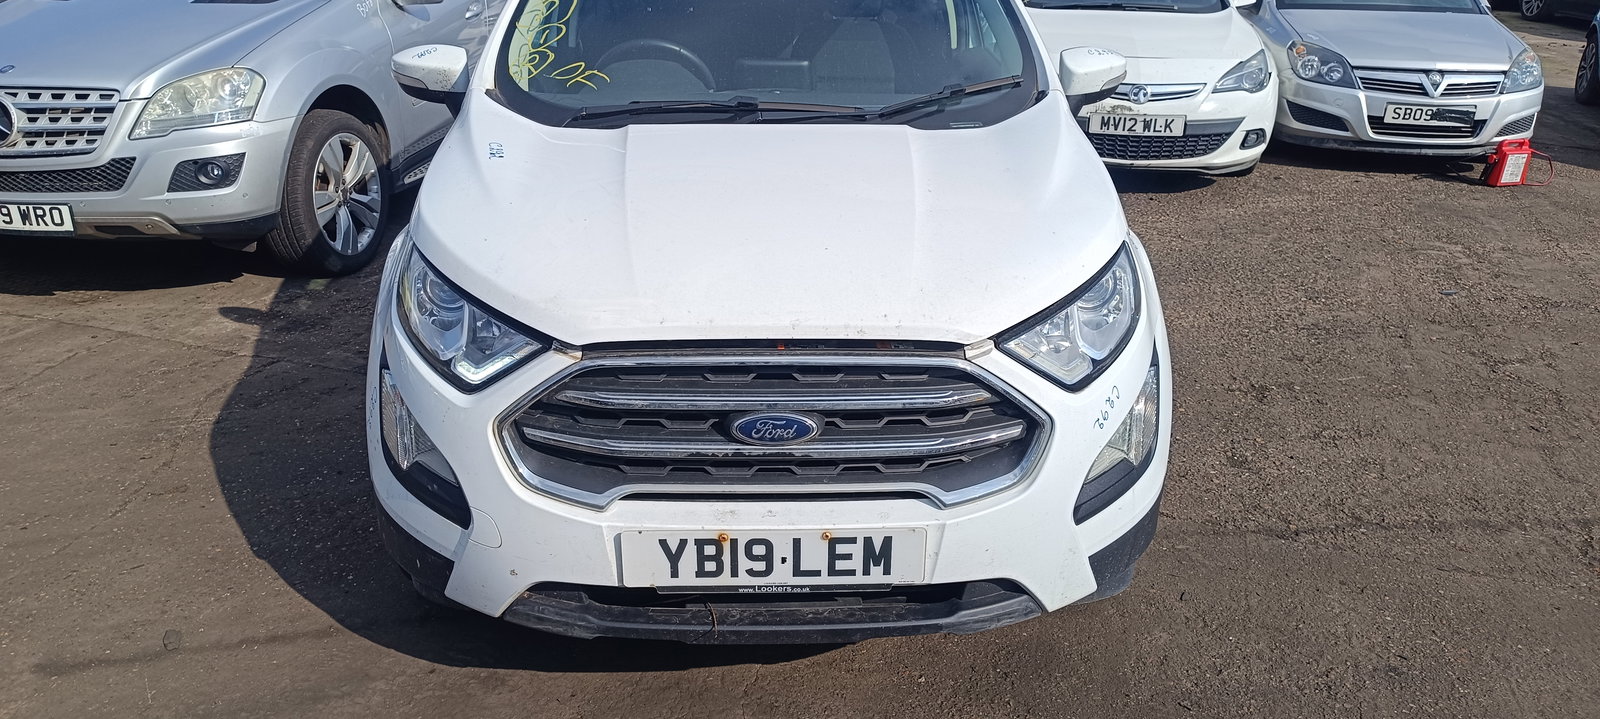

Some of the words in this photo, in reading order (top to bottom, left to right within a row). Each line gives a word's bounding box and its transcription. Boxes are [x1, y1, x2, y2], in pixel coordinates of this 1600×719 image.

[1100, 116, 1138, 132] MV12
[1142, 117, 1175, 134] WLK
[17, 205, 65, 227] WRO
[751, 419, 798, 439] Ford
[658, 537, 775, 579] YB19
[792, 535, 893, 578] LEM
[738, 585, 811, 594] www.Lookers.co.uk
